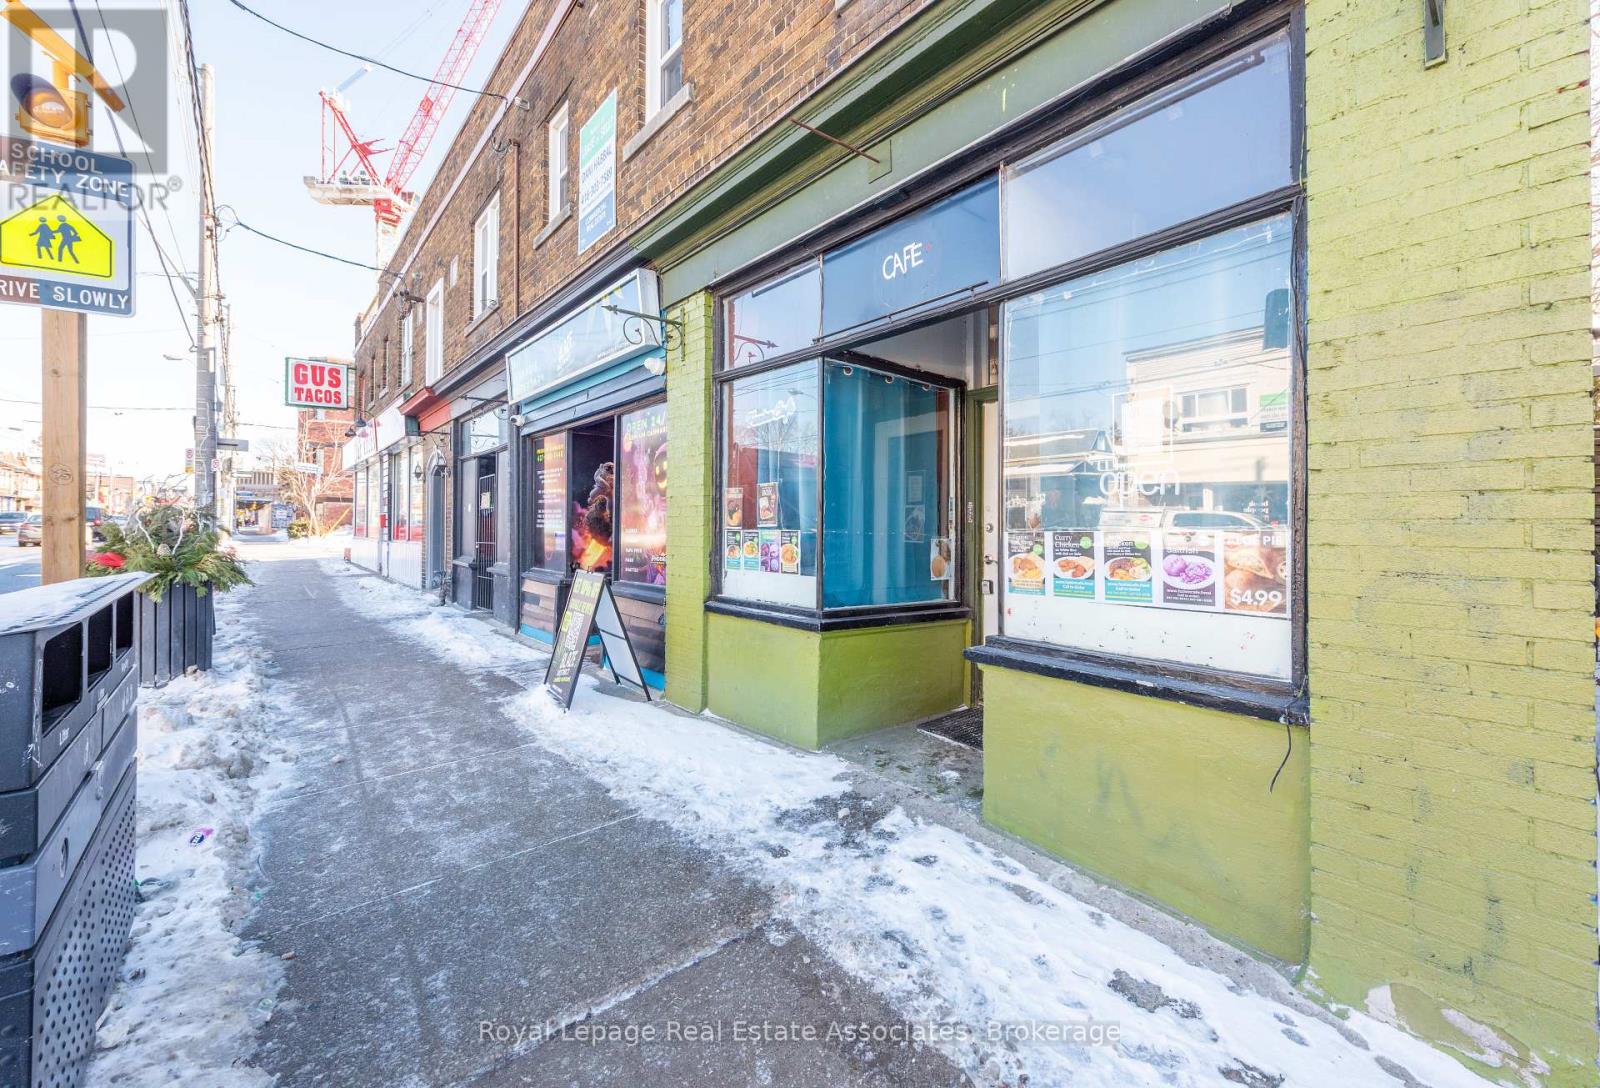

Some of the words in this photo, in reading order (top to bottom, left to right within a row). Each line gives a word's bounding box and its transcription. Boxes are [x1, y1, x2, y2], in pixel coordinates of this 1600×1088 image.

[11, 143, 103, 175] SCHOOL
[76, 173, 129, 198] ZONE
[882, 241, 924, 280] CAFE
[53, 286, 129, 309] SLOWLY
[294, 363, 341, 389] GUS
[294, 387, 341, 405] TACOS
[1054, 534, 1073, 543] Curry
[1230, 587, 1282, 606] $4.99
